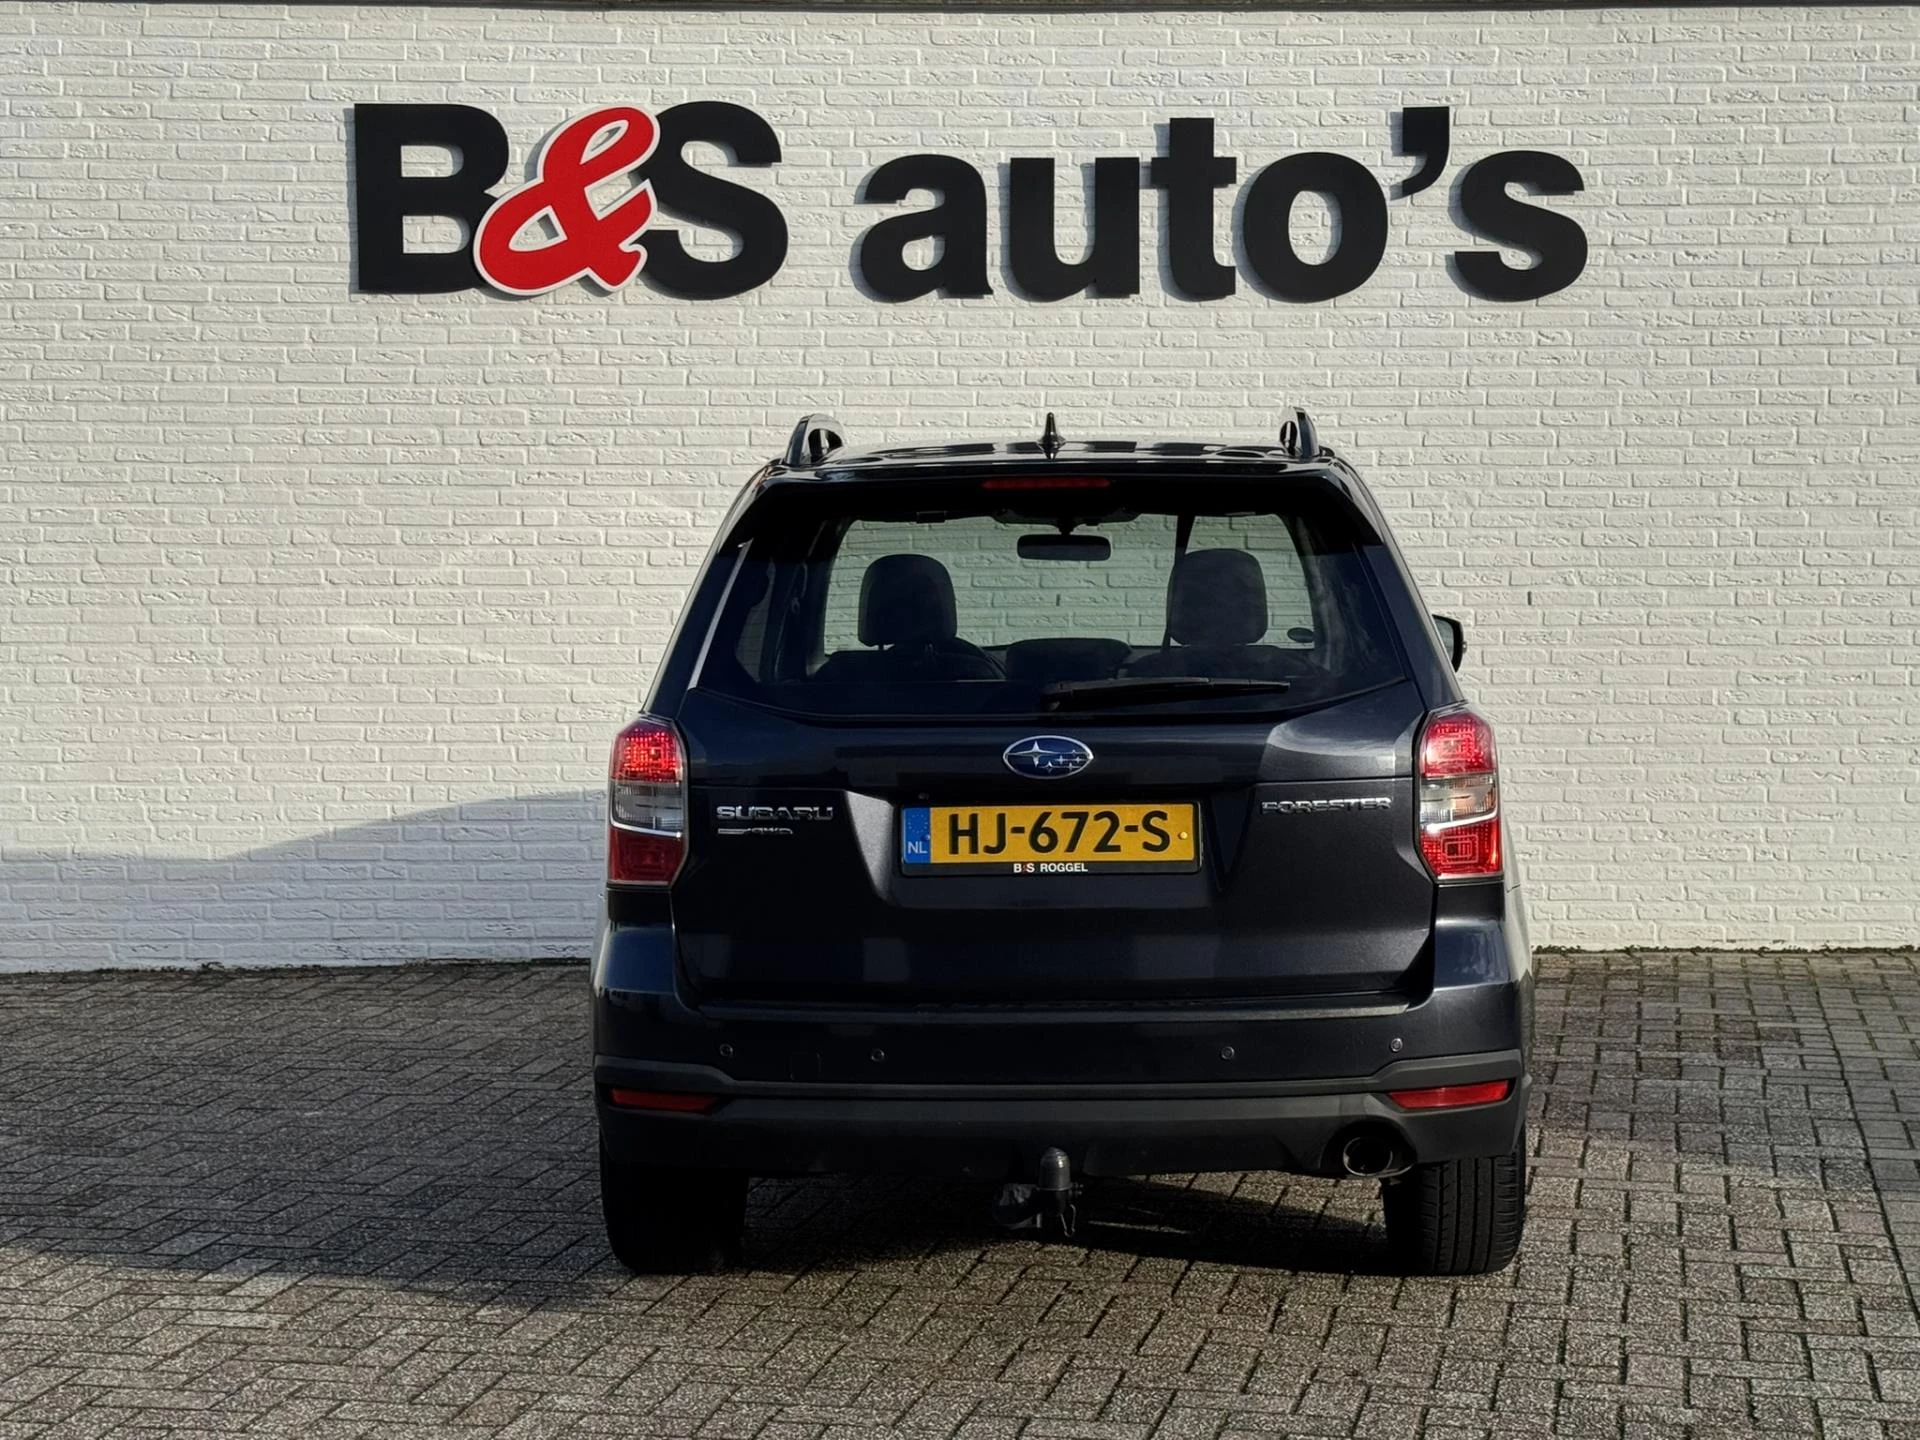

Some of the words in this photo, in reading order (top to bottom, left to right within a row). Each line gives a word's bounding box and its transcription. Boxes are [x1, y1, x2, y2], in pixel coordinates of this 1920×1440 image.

[353, 101, 788, 300] B&S
[858, 107, 1588, 302] auto's
[716, 805, 833, 820] SUBARU
[1260, 797, 1392, 815] FORESTER
[948, 810, 1170, 855] HJ-672-S
[907, 841, 928, 854] NL
[1040, 862, 1088, 873] ROGGEL
